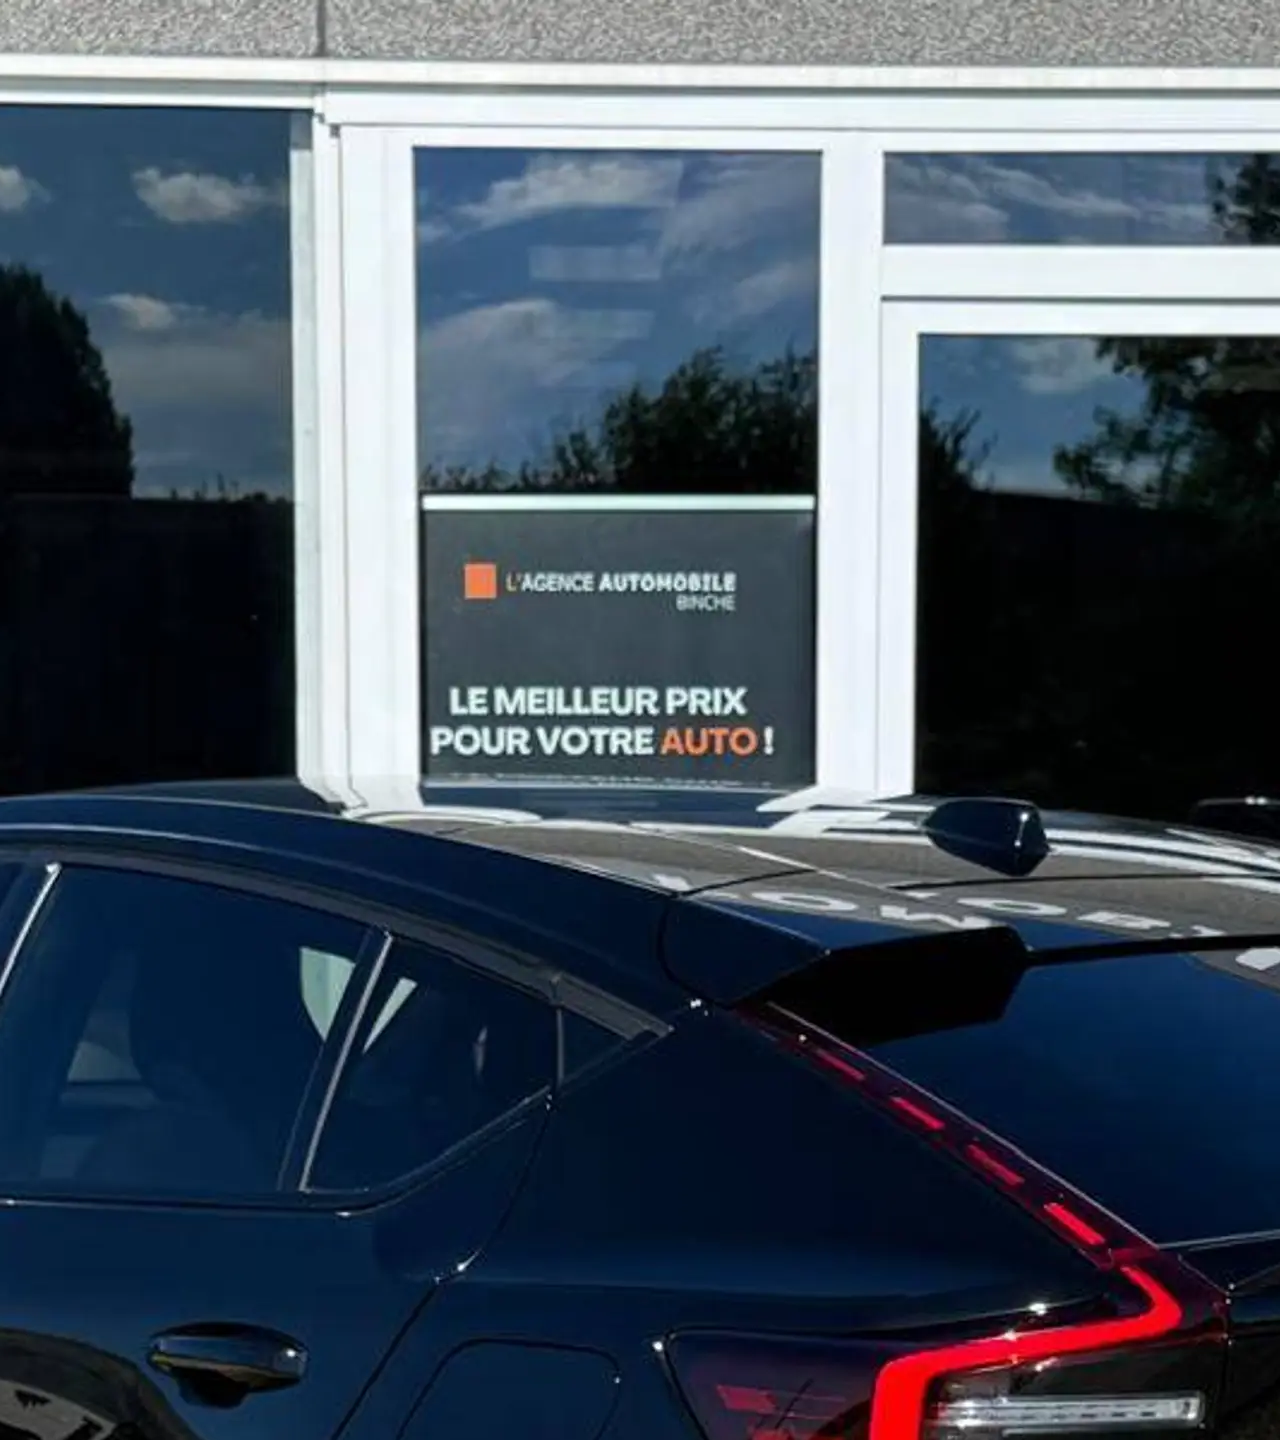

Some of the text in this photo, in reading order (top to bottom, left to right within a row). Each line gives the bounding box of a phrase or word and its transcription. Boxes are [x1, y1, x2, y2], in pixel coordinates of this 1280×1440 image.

[505, 572, 737, 592] L'AGENCE AUTOMOBILE
[676, 594, 736, 612] BINCHE
[449, 686, 748, 716] LE MEILLEUR PRIX
[429, 726, 532, 756] POUR
[536, 726, 655, 756] VOTRE
[660, 726, 758, 756] AUTO
